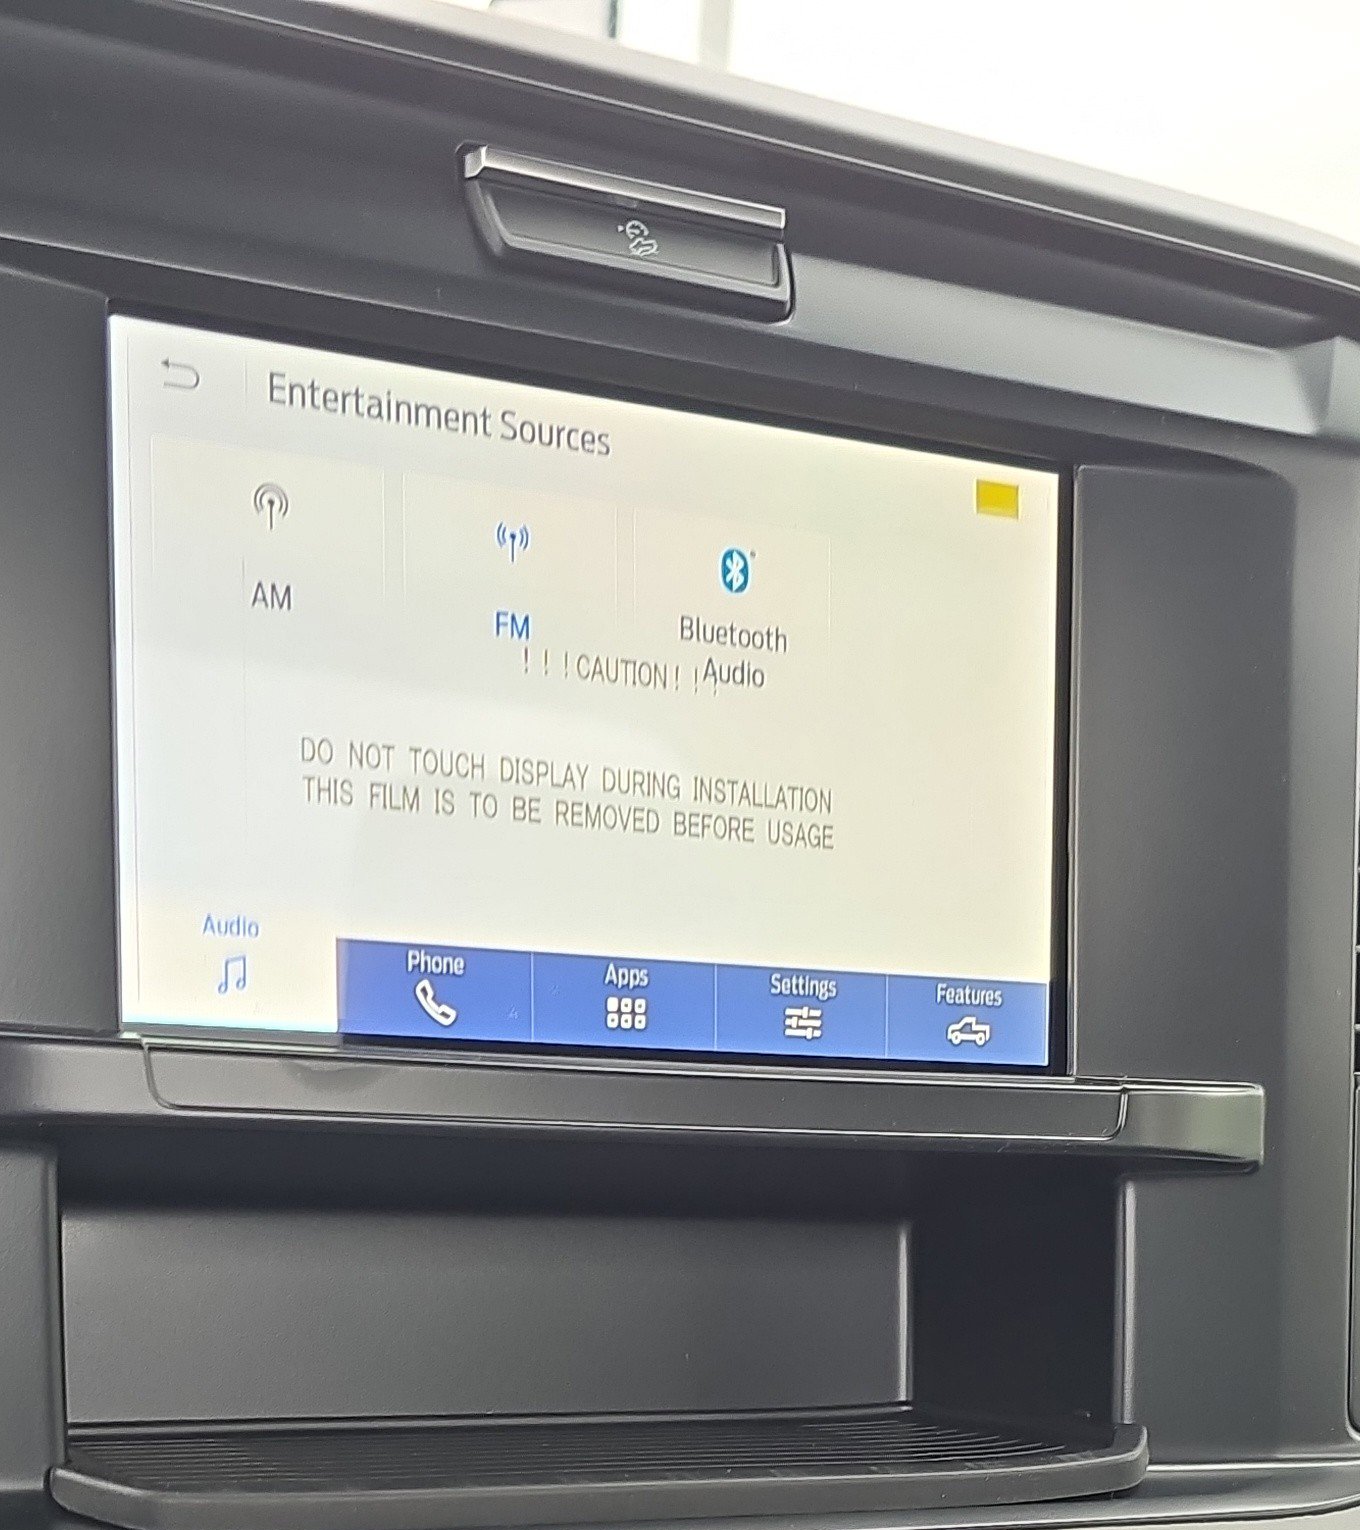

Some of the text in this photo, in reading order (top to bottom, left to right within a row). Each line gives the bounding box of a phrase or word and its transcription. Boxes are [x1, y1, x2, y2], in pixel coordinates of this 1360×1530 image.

[268, 371, 611, 456] Entertainment Sources
[250, 581, 292, 611] AM
[495, 611, 530, 640] FM
[680, 615, 787, 653] Bluetooth
[703, 657, 765, 689] Audio
[301, 737, 832, 815] DO NOT TOUCH DISPLAY DURING INSTALLATION
[303, 775, 834, 850] THIS FILM IS TO BE REMOVED BEFORE USAGE
[202, 913, 259, 938] Audio
[406, 949, 466, 976] Phone
[604, 962, 648, 989] Apps
[769, 972, 837, 1001] Settings
[935, 983, 1003, 1007] Features
